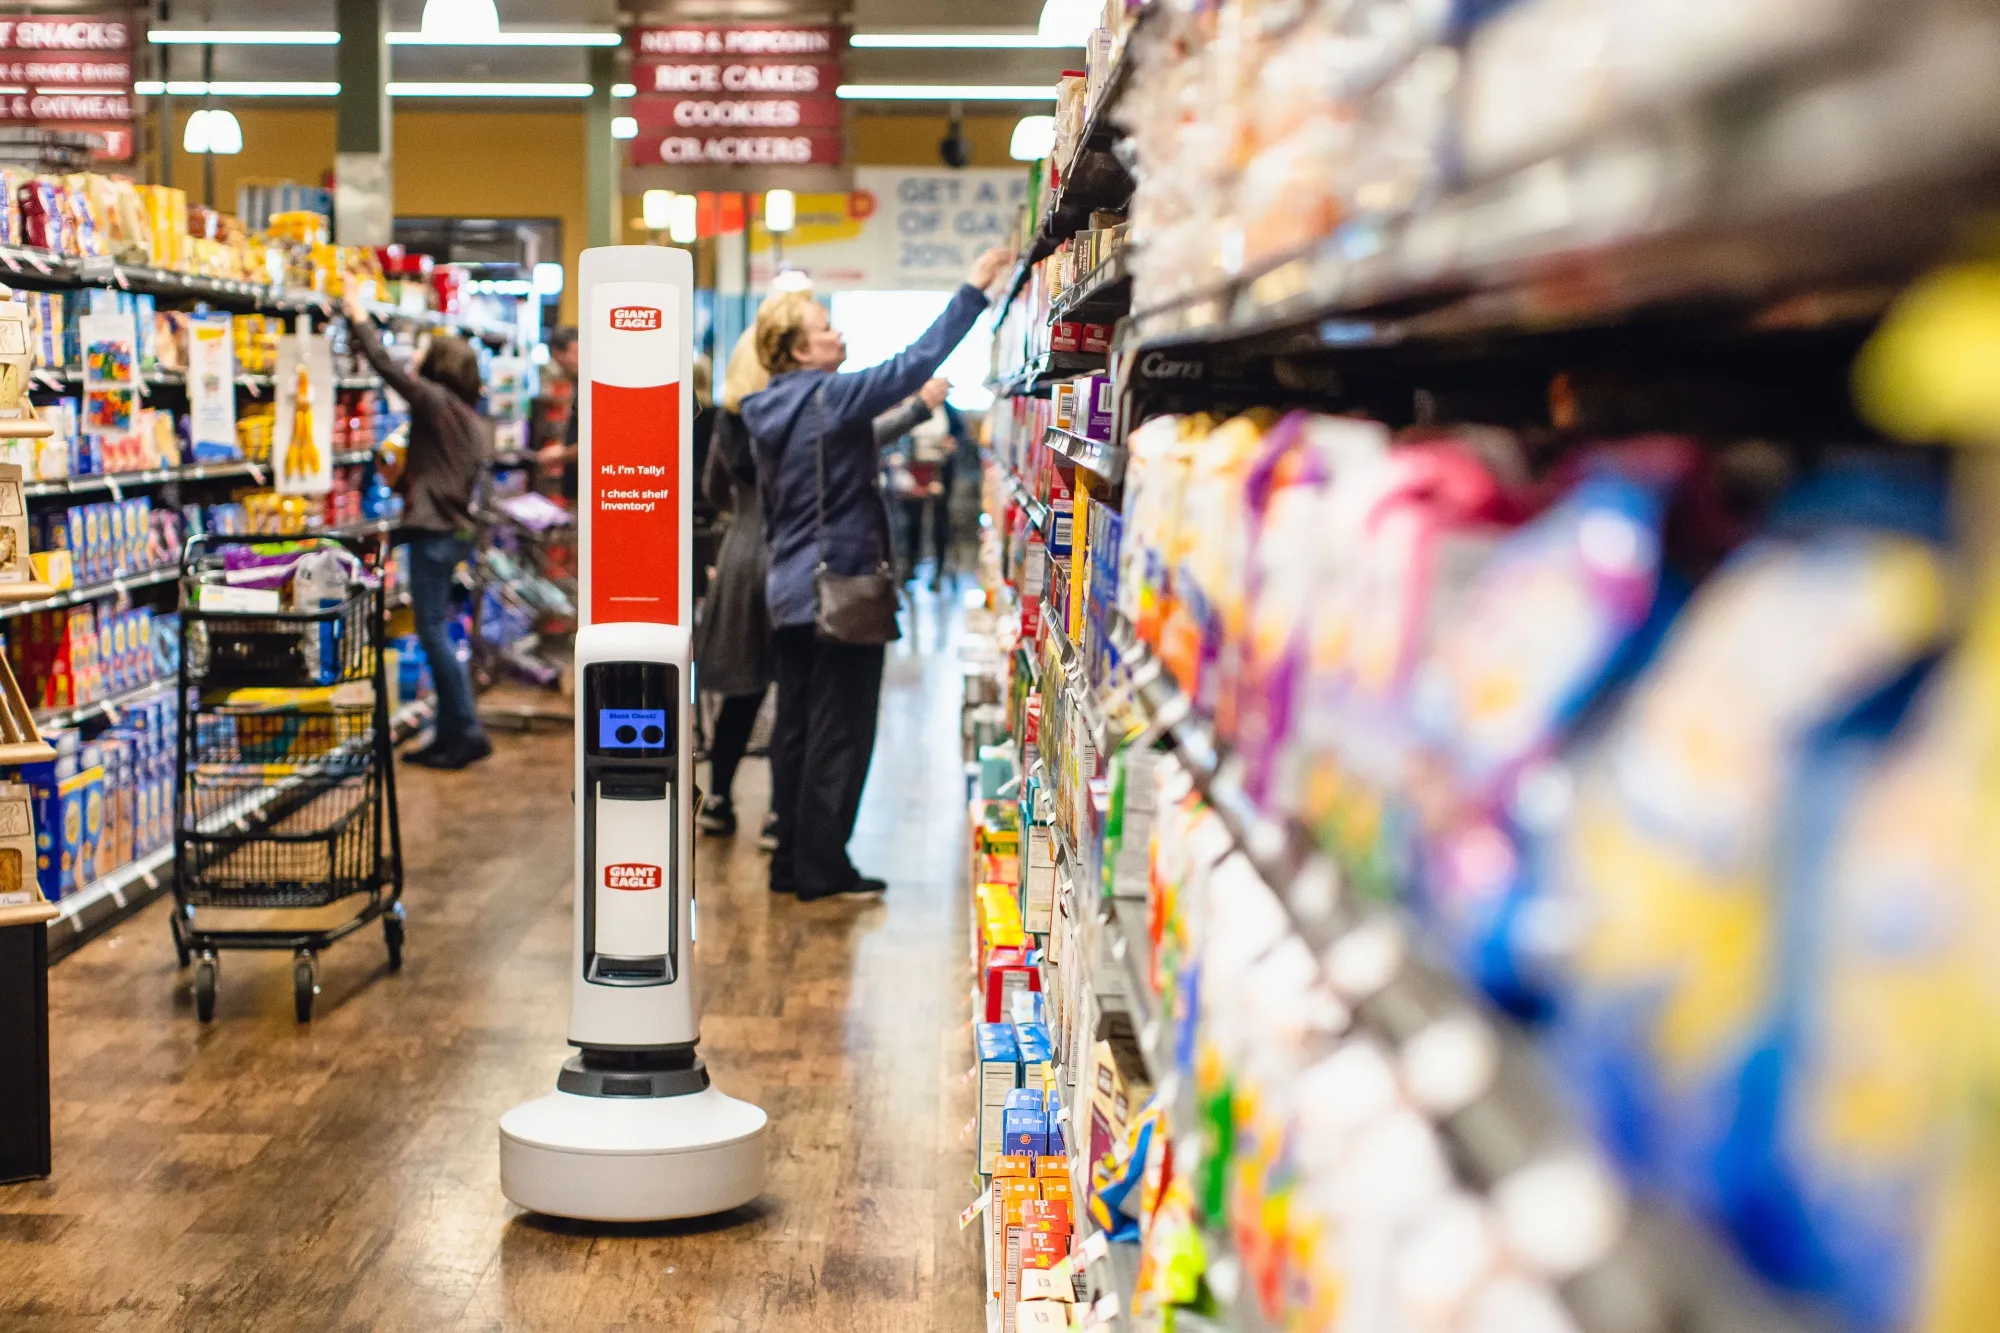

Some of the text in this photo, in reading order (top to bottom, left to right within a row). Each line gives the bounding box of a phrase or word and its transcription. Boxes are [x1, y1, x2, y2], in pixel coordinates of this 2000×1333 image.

[16, 22, 127, 49] SNACKS
[641, 31, 830, 53] NUTS & POPCORN
[655, 65, 819, 92] RICE CAKES
[31, 96, 131, 119] OATMEAL
[673, 100, 800, 127] COOKIES
[660, 136, 812, 164] CRACKERS
[898, 179, 961, 203] GET
[974, 180, 999, 203] A
[898, 209, 941, 235] OF
[614, 309, 657, 319] GIANT
[614, 319, 657, 328] EAGLE
[601, 465, 616, 476] Hi,
[637, 465, 665, 477] Tally!
[601, 489, 669, 499] I check shelf
[601, 501, 655, 513] inventory!
[609, 866, 656, 877] GIANT
[610, 877, 656, 888] EAGLE
